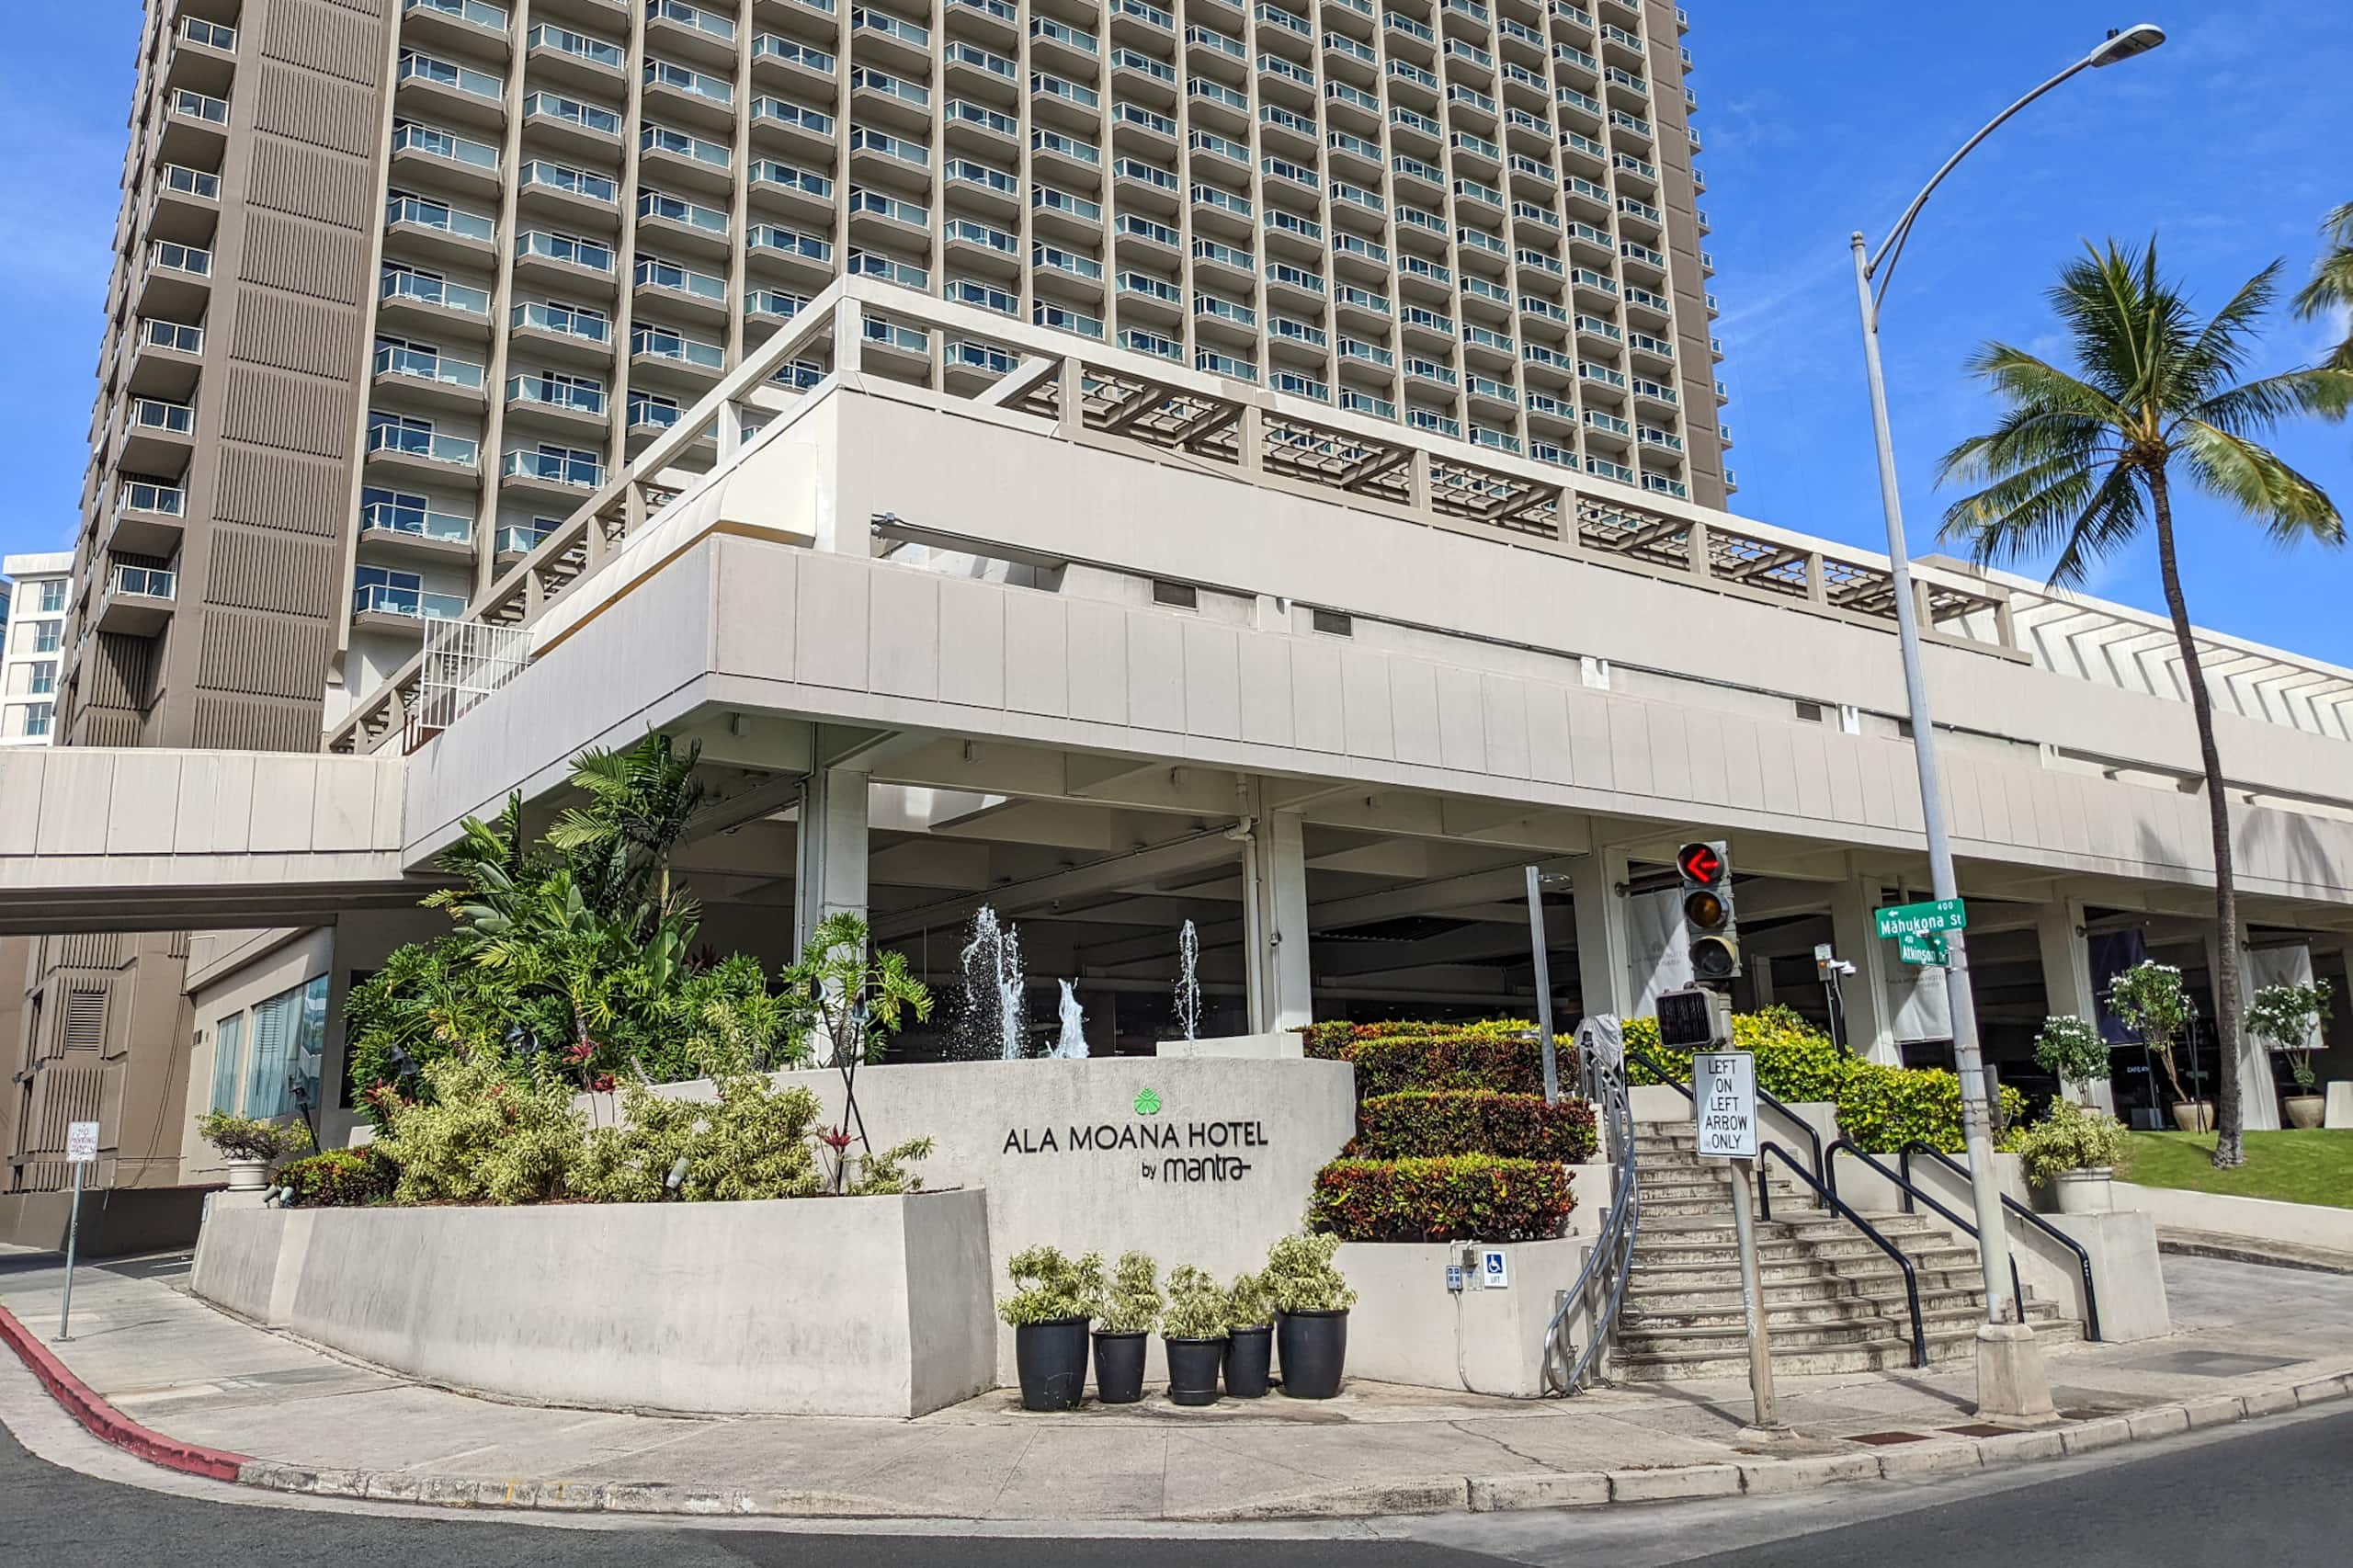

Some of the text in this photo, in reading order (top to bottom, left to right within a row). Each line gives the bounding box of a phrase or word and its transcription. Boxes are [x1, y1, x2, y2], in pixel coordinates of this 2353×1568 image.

[1938, 902, 1953, 911] 400
[1950, 915, 1961, 926] St
[1903, 945, 1936, 964] Atkinson
[1708, 1059, 1736, 1074] LEFT
[1715, 1078, 1733, 1093] ON
[1711, 1096, 1739, 1111] LEFT
[1705, 1115, 1748, 1131] ARROW
[1003, 1120, 1268, 1154] ALA MOANA HOTEL
[1711, 1133, 1742, 1149] ONLY
[1142, 1153, 1252, 1183] by mantra
[1491, 1276, 1500, 1284] LIFT
